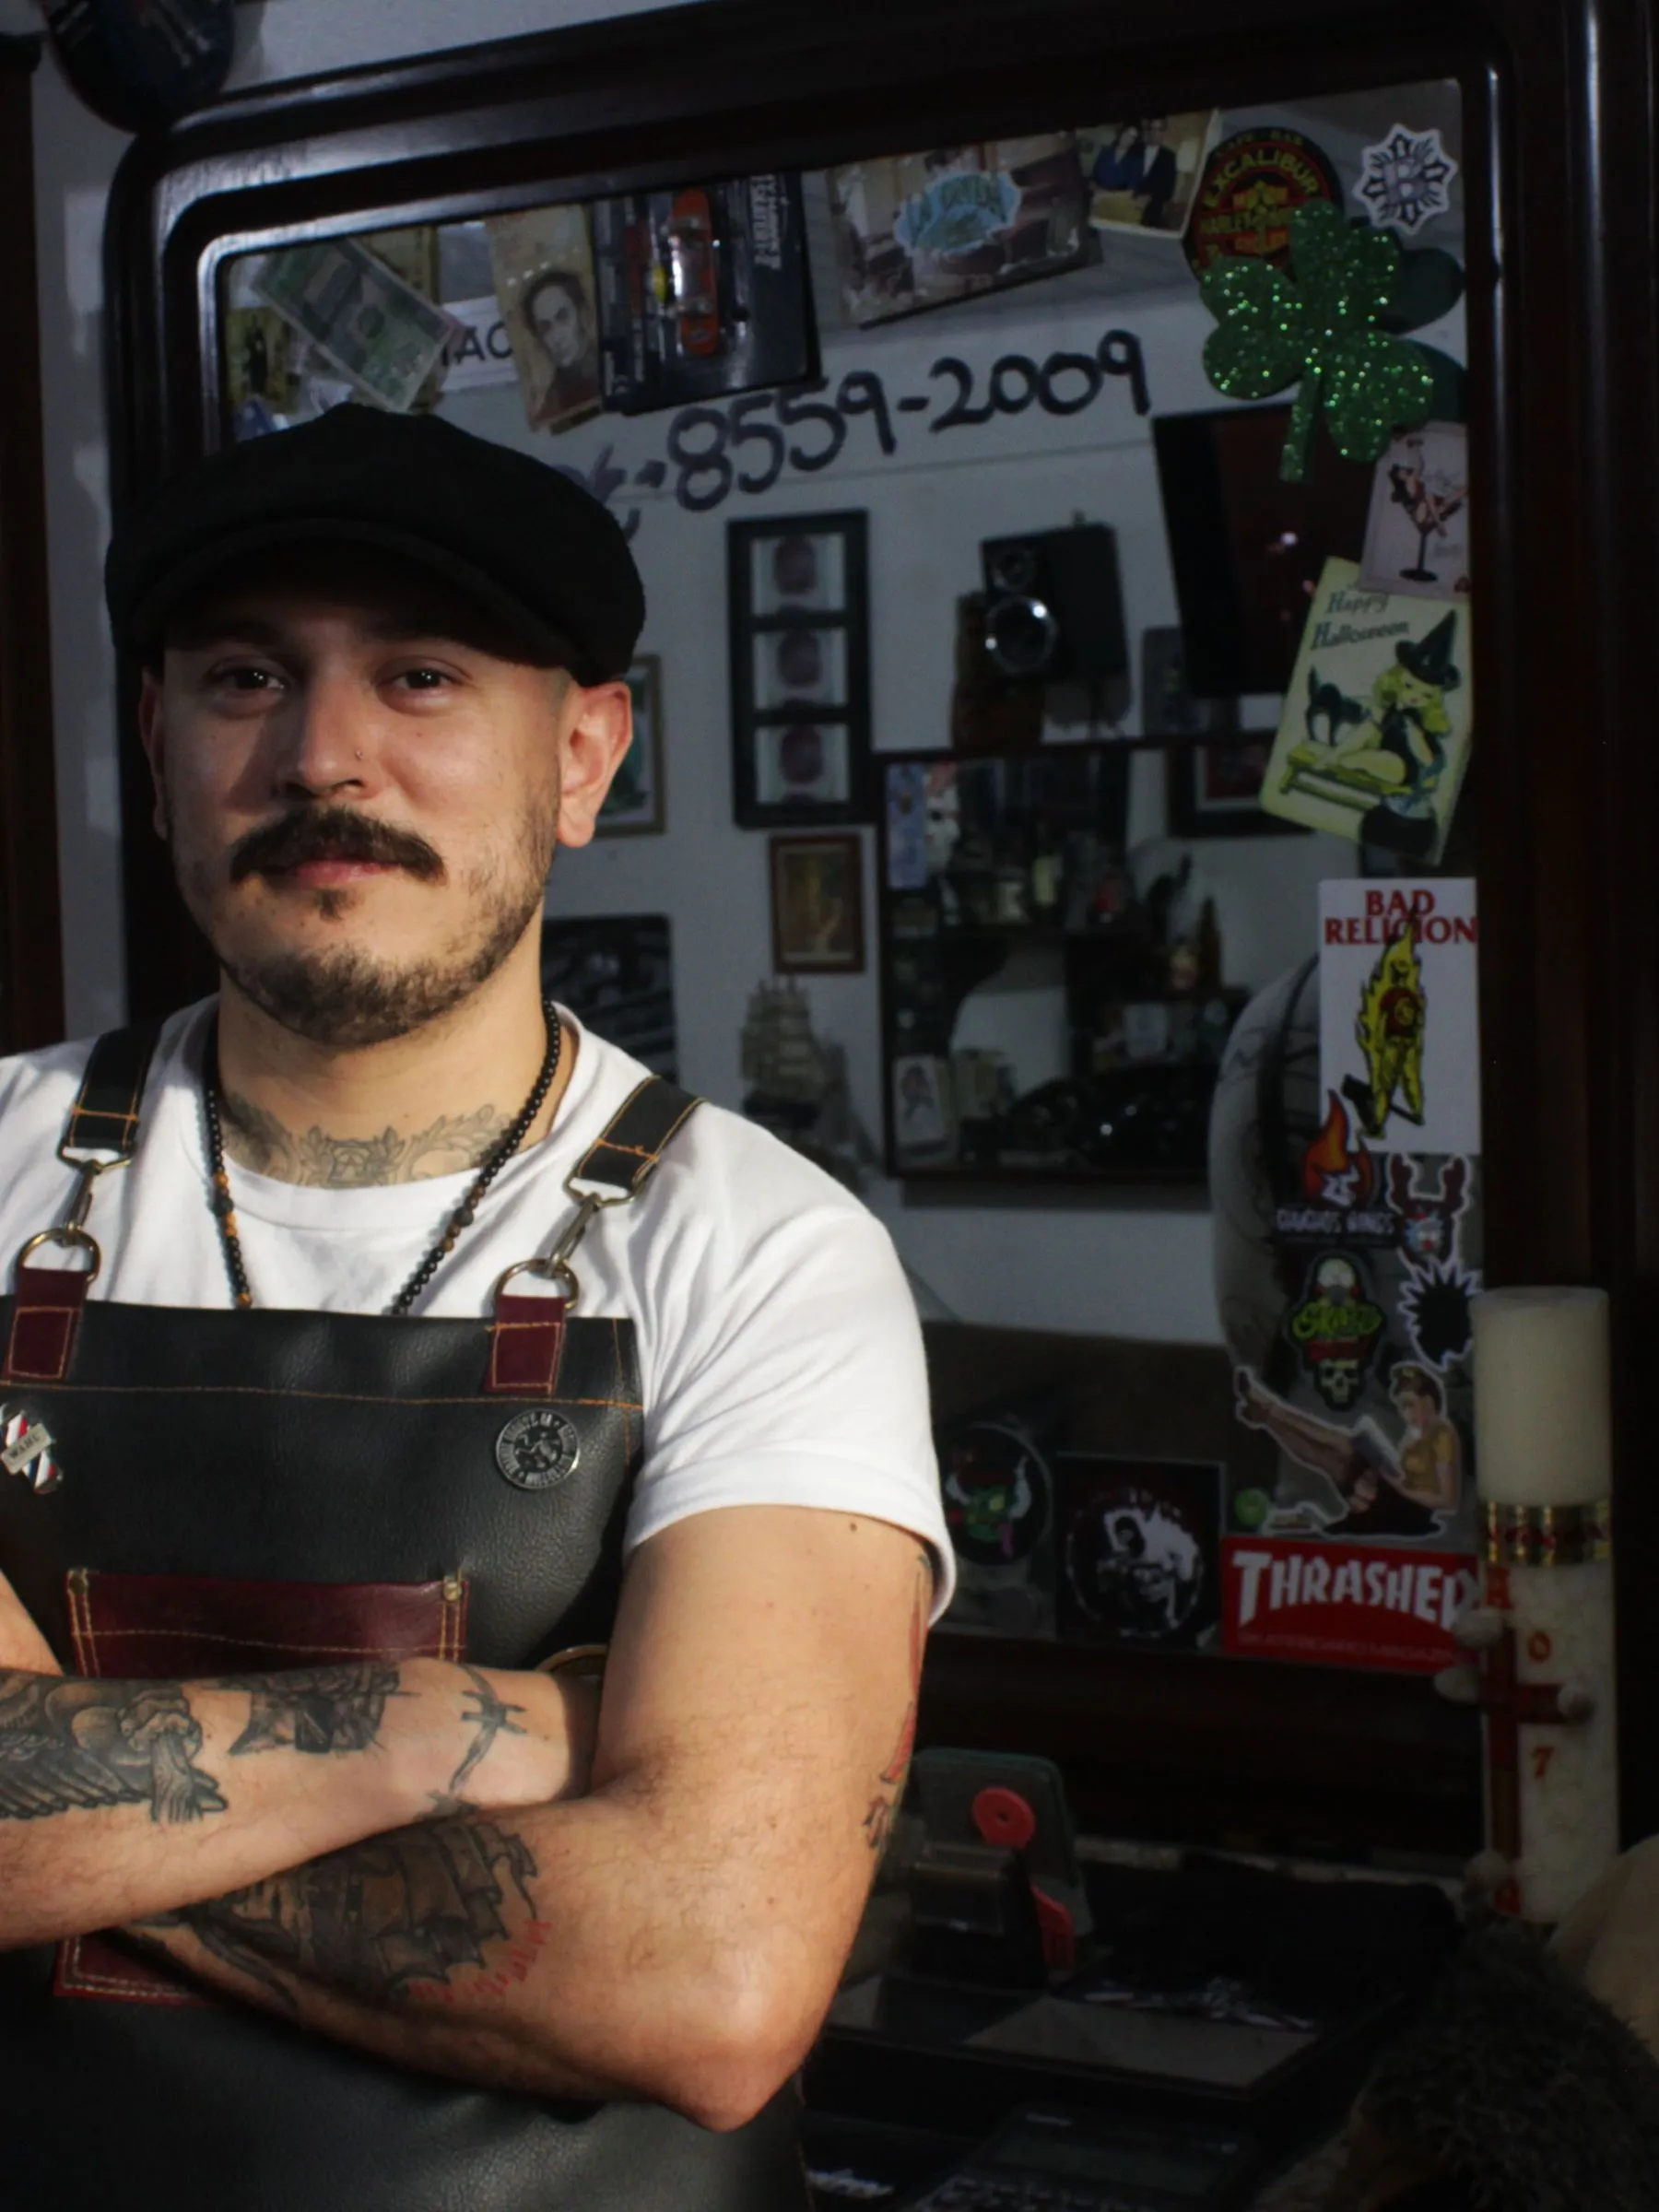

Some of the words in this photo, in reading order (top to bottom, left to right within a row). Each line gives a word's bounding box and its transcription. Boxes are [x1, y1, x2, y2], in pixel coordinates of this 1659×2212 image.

[1202, 148, 1321, 208] EXCALIBUR
[1327, 590, 1390, 616] Happy
[1366, 888, 1435, 917] BAD
[1531, 1745, 1556, 1778] 7
